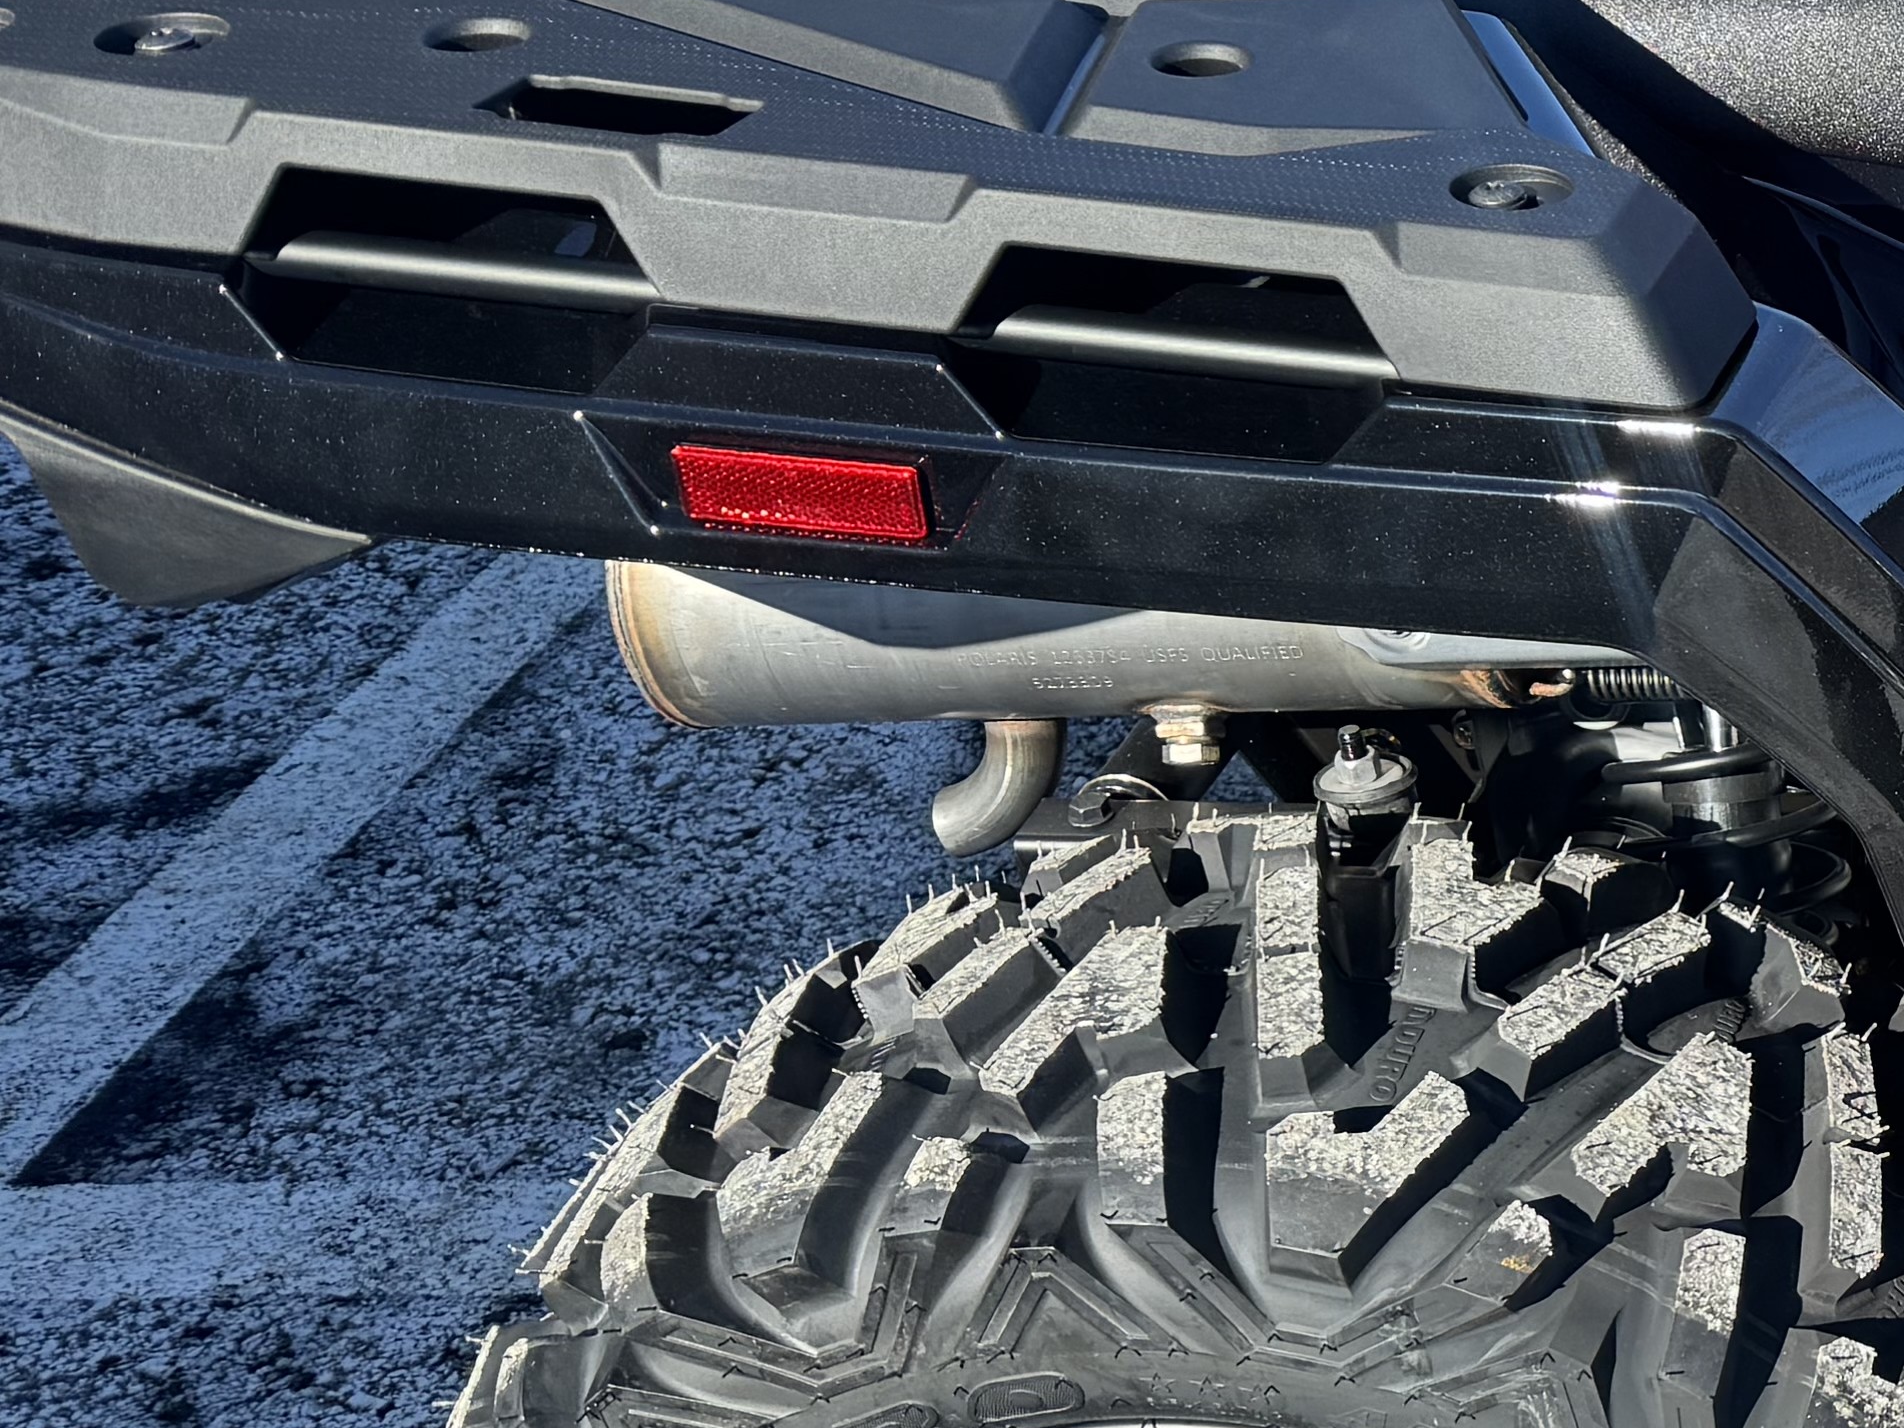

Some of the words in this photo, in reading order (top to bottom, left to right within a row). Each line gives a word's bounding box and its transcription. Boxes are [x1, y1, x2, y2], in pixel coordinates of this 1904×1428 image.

[957, 649, 1038, 668] POLARIS
[1143, 643, 1190, 663] USFS
[1201, 644, 1304, 663] QUALIFIED
